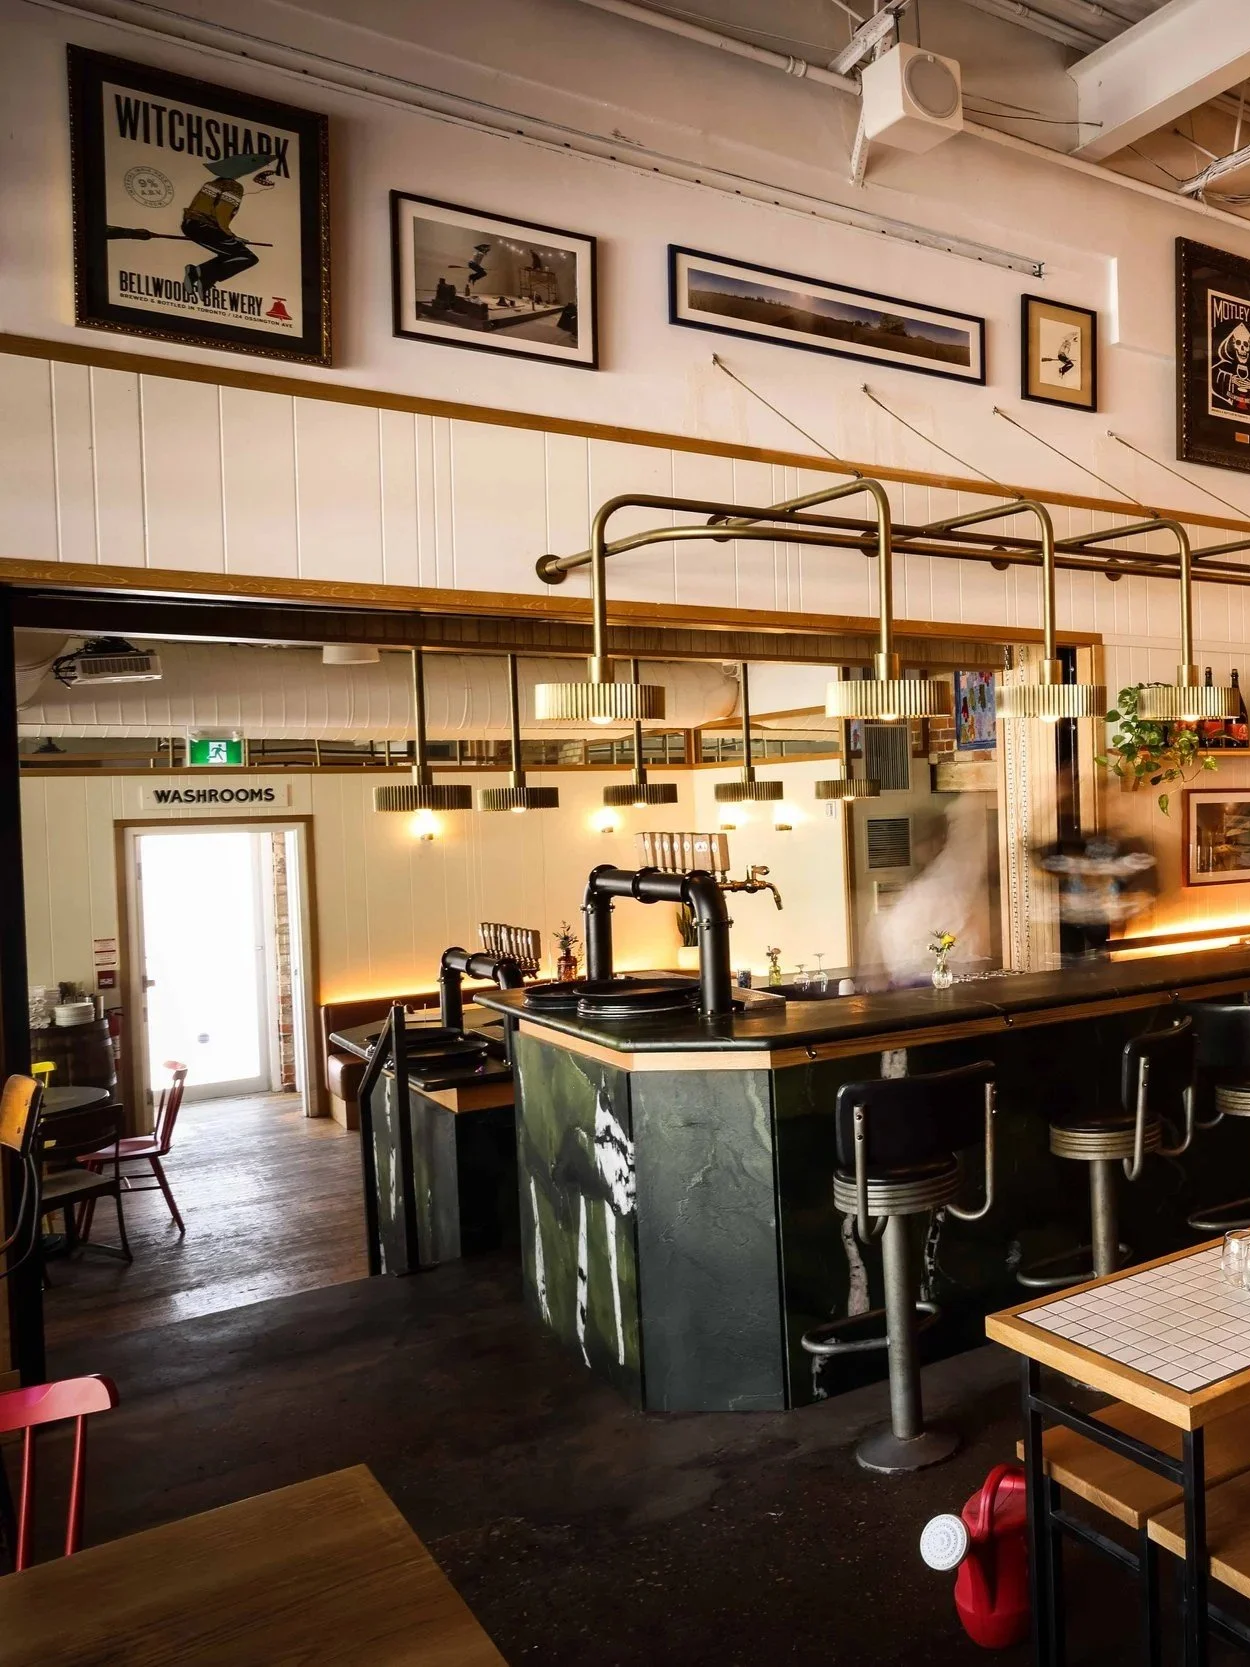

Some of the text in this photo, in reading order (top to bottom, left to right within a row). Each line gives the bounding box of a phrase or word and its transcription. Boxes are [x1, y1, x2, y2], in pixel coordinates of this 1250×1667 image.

[115, 94, 290, 178] WITCHSHARK
[138, 179, 159, 188] 9%
[119, 269, 263, 317] BELLWOODS BREWERY
[119, 293, 148, 302] BREWED
[157, 300, 186, 309] BOTTLED
[197, 307, 226, 317] TORONTO
[244, 315, 280, 326] OSSINGTON
[1213, 297, 1250, 328] MOTLEY
[153, 788, 275, 804] WASHROOMS
